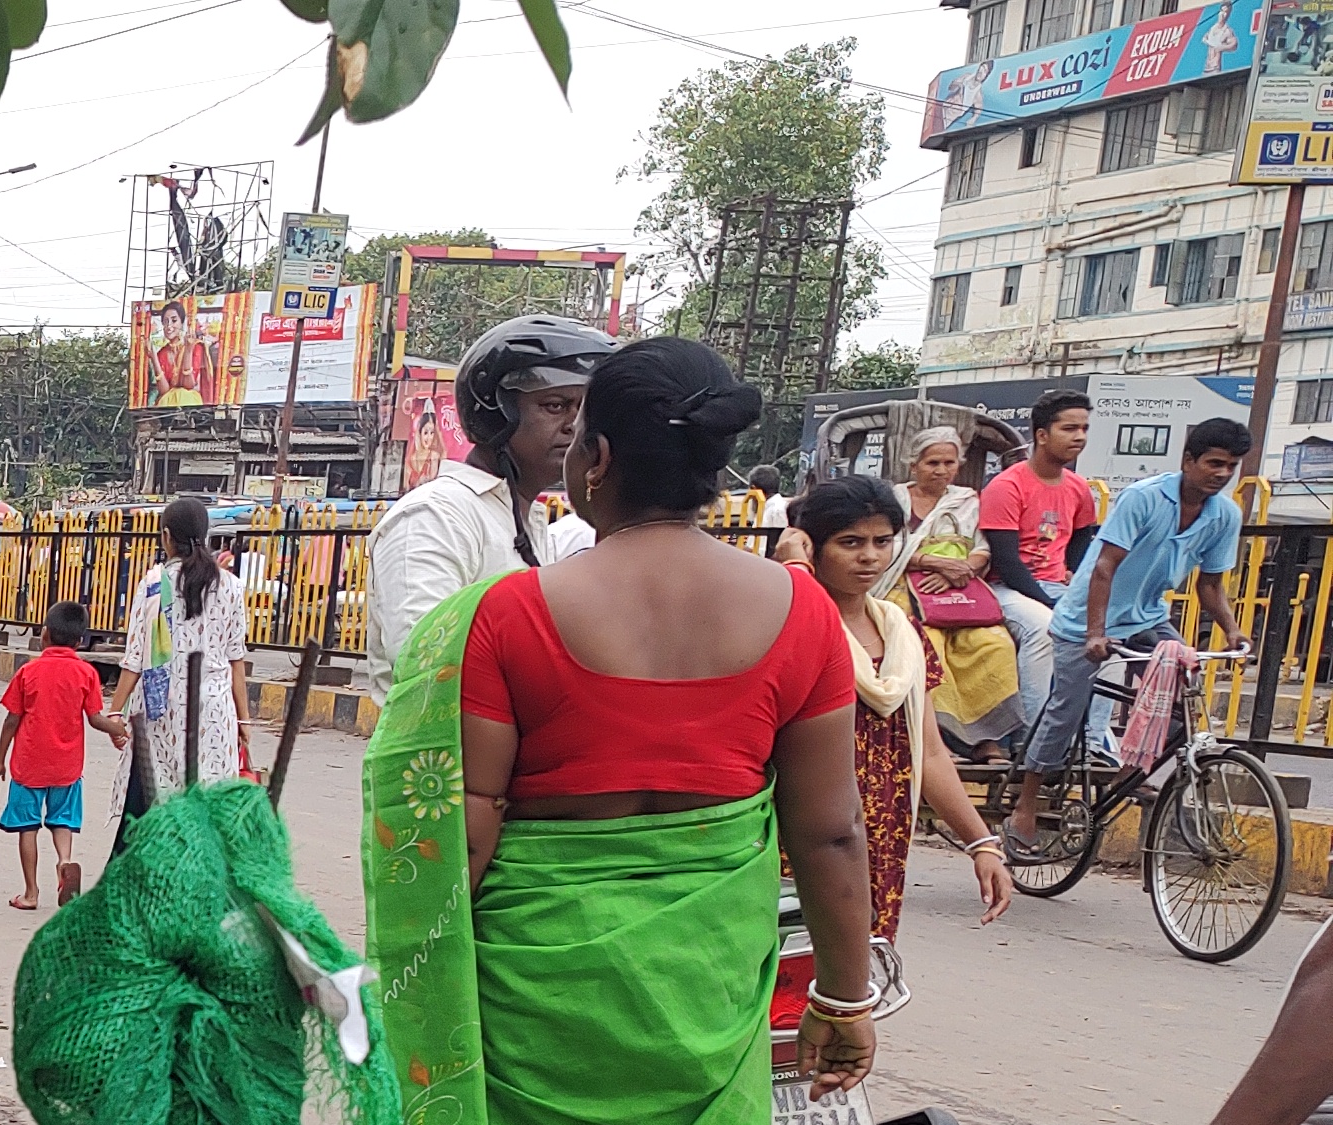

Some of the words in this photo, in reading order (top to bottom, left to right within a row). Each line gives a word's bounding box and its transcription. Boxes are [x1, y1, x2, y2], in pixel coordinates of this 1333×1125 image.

[1132, 25, 1184, 58] EKDUM
[999, 58, 1059, 91] LUX
[1126, 52, 1166, 82] COZY
[1022, 83, 1079, 105] UNDERWEAR
[1302, 136, 1333, 162] LI
[304, 293, 326, 309] LIC
[1096, 398, 1130, 408] কোনও
[866, 432, 886, 444] TAT
